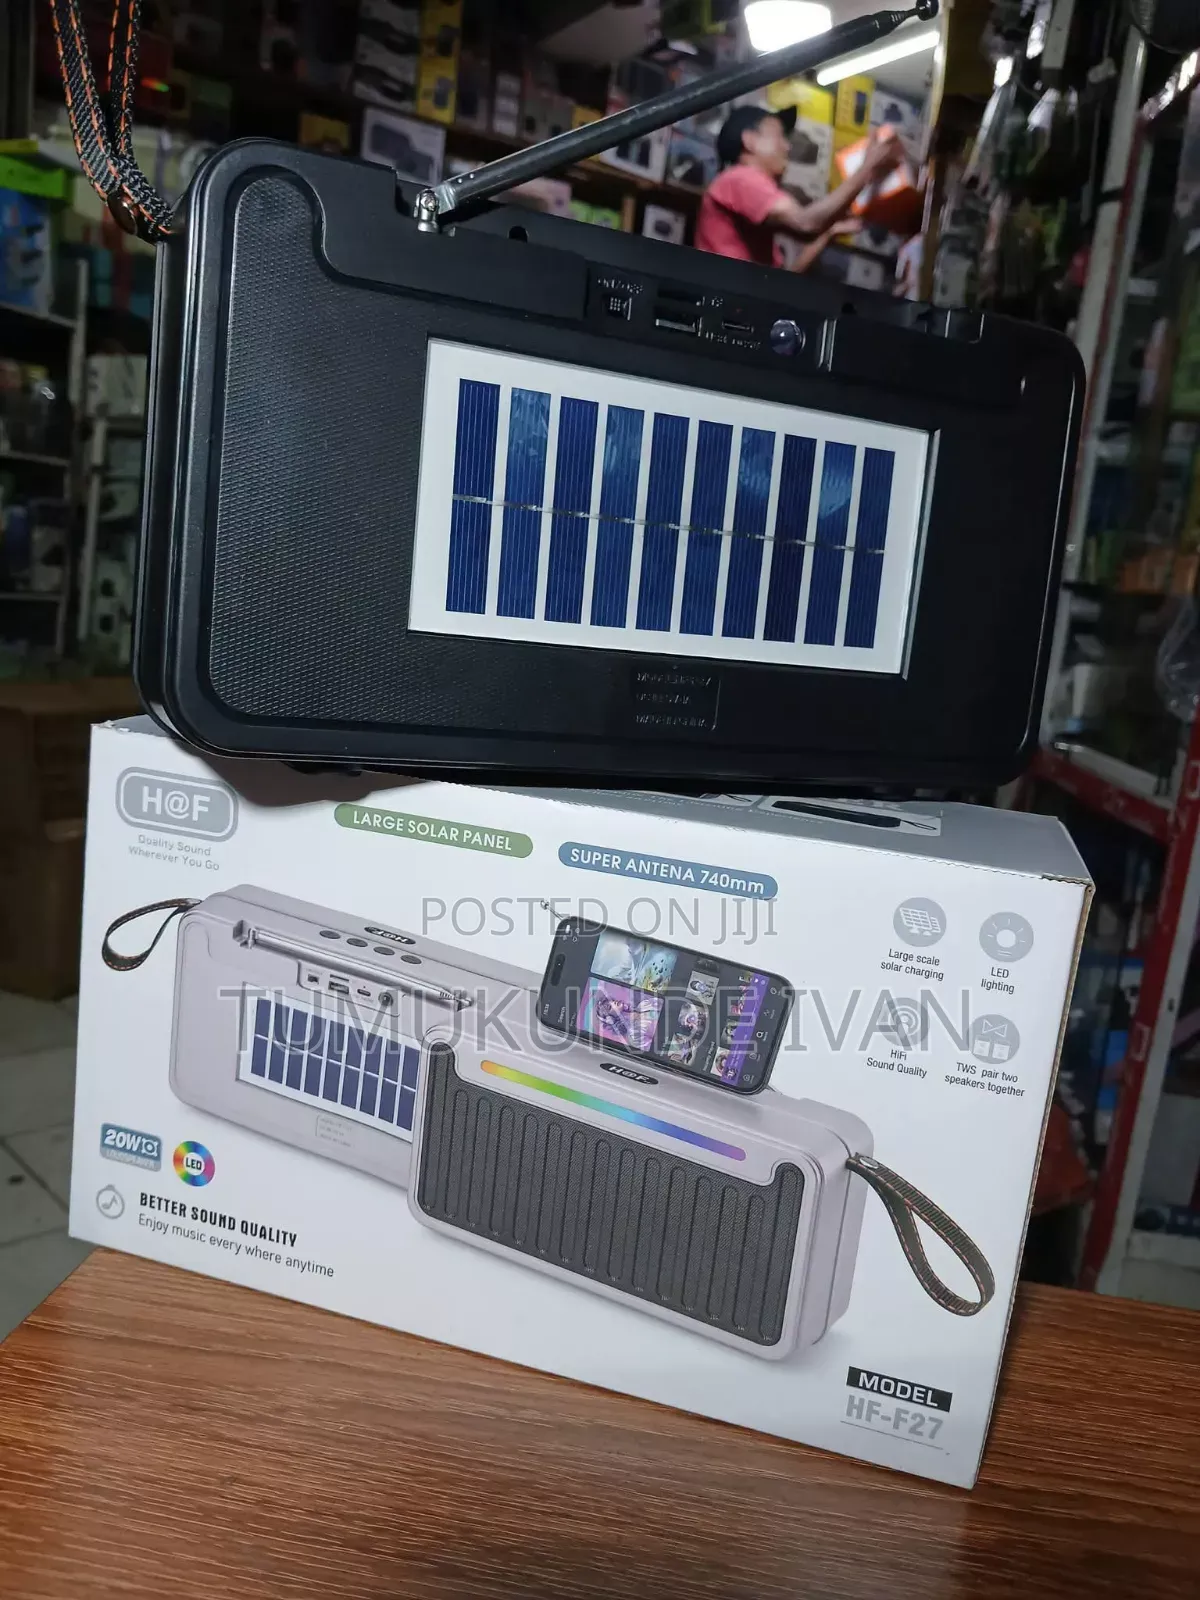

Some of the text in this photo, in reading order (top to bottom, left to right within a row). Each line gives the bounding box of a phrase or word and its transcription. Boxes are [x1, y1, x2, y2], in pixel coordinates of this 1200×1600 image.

[142, 785, 211, 821] H@F
[353, 810, 512, 850] LARGE SOLAR PANEL
[138, 834, 211, 856] Quality Sound
[128, 845, 220, 871] Wherever You Go
[570, 848, 764, 894] SUPER ANTENA 740mm
[888, 949, 940, 966] Large scale
[880, 961, 944, 981] solar charging
[991, 967, 1009, 978] LED
[981, 979, 1015, 994] lighting
[890, 1049, 907, 1060] HiFi
[867, 1057, 927, 1079] Sound Quality
[956, 1062, 1018, 1083] TWS pair two
[944, 1074, 1025, 1097] speakers together
[104, 1129, 141, 1152] 20W
[186, 1157, 203, 1170] LED
[140, 1192, 297, 1247] BETTER SOUND QUALITY
[138, 1213, 334, 1277] Enjoy music every where anytime
[858, 1372, 938, 1407] MODEL
[846, 1395, 944, 1439] HF-F27
